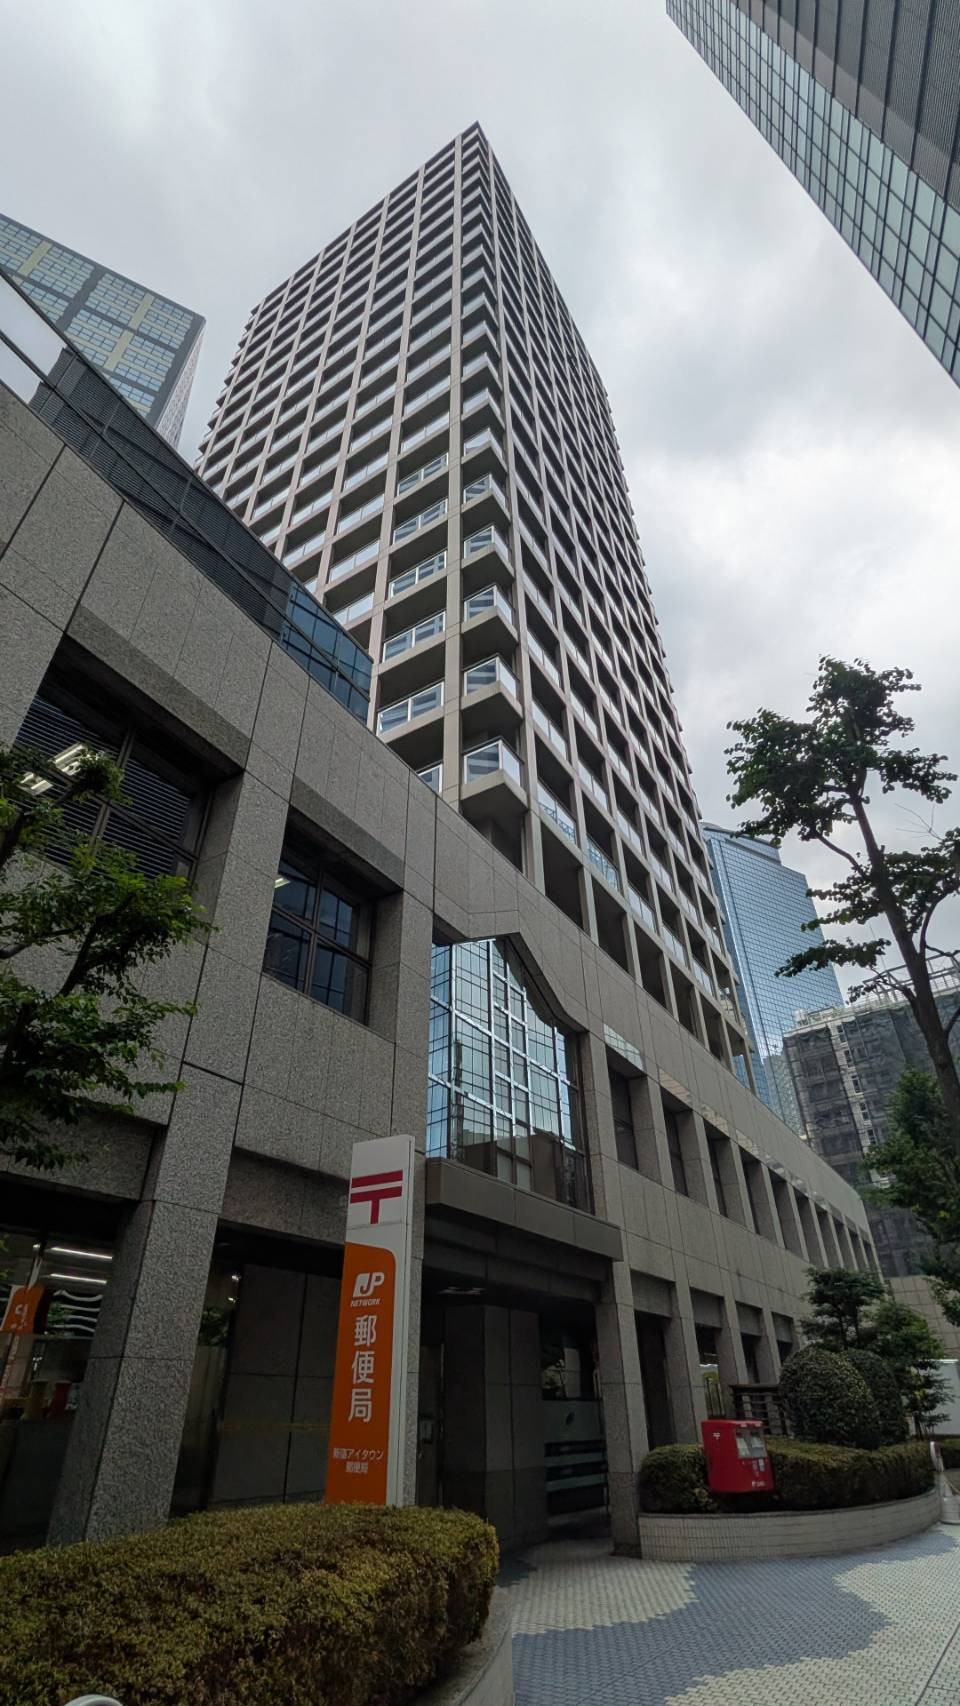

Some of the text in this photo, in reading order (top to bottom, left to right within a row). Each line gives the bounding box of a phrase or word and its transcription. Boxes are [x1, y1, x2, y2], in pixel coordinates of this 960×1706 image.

[350, 1298, 381, 1307] NETWORK
[348, 1315, 378, 1423] 郵便局
